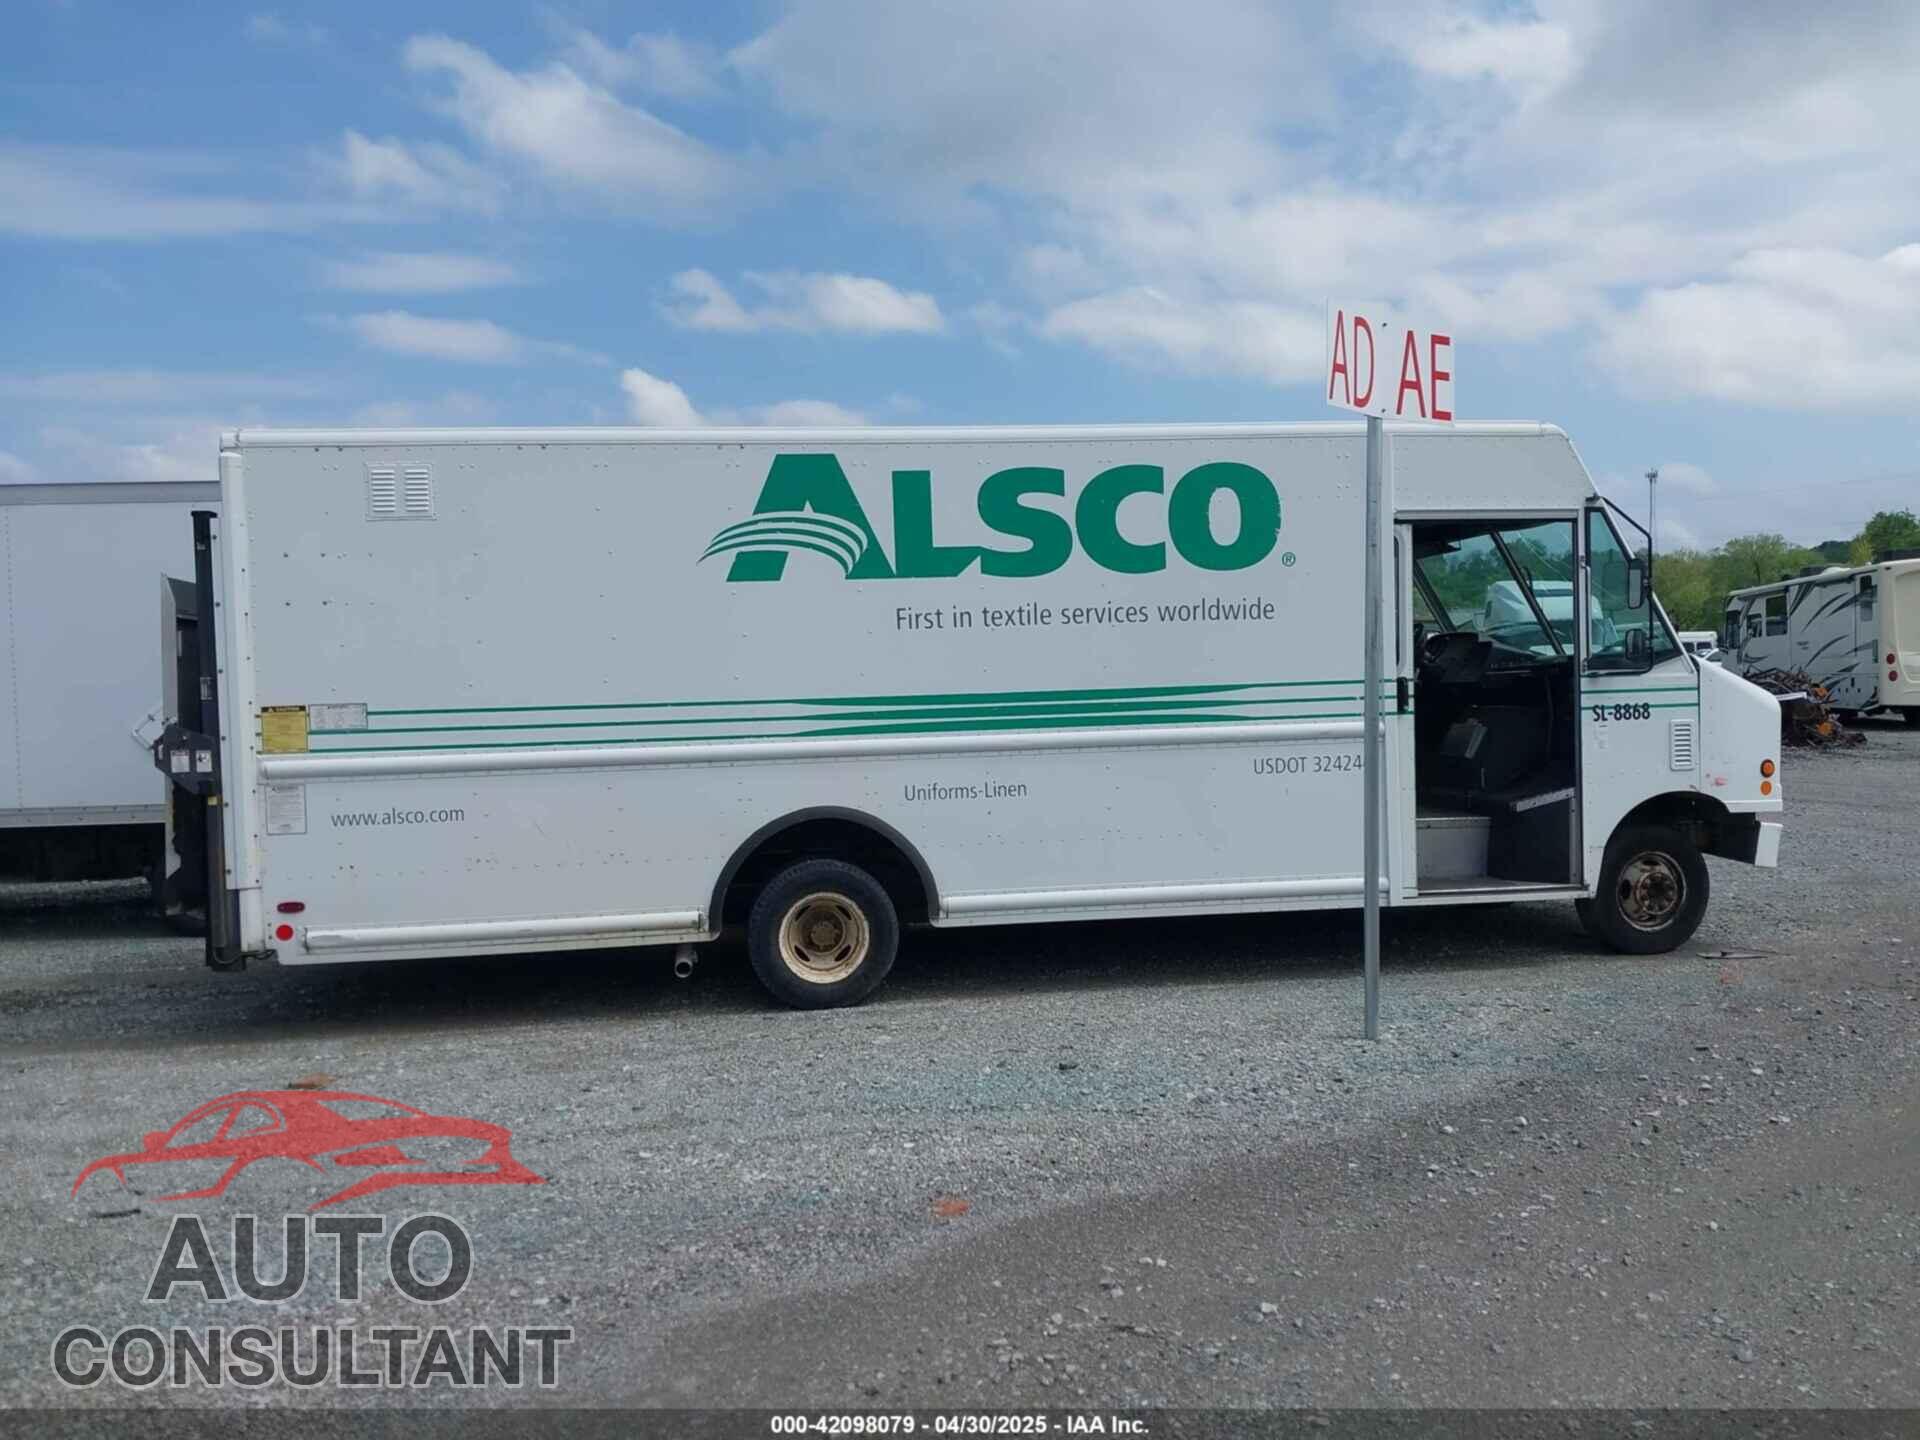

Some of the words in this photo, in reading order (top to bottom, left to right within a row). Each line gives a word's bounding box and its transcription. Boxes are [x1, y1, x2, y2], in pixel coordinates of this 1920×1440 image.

[1329, 310, 1375, 408] AD
[1396, 330, 1452, 421] AE
[697, 453, 1282, 582] ALSCO
[896, 607, 943, 630] First
[952, 605, 972, 628] in
[982, 601, 1052, 627] textile
[1060, 600, 1149, 624] services
[1158, 597, 1275, 622] worldwide
[1592, 703, 1651, 721] SL-8868
[1254, 756, 1307, 774] USDOT
[904, 782, 1027, 801] Uniforms-Linen
[331, 808, 465, 827] www.alsco.com
